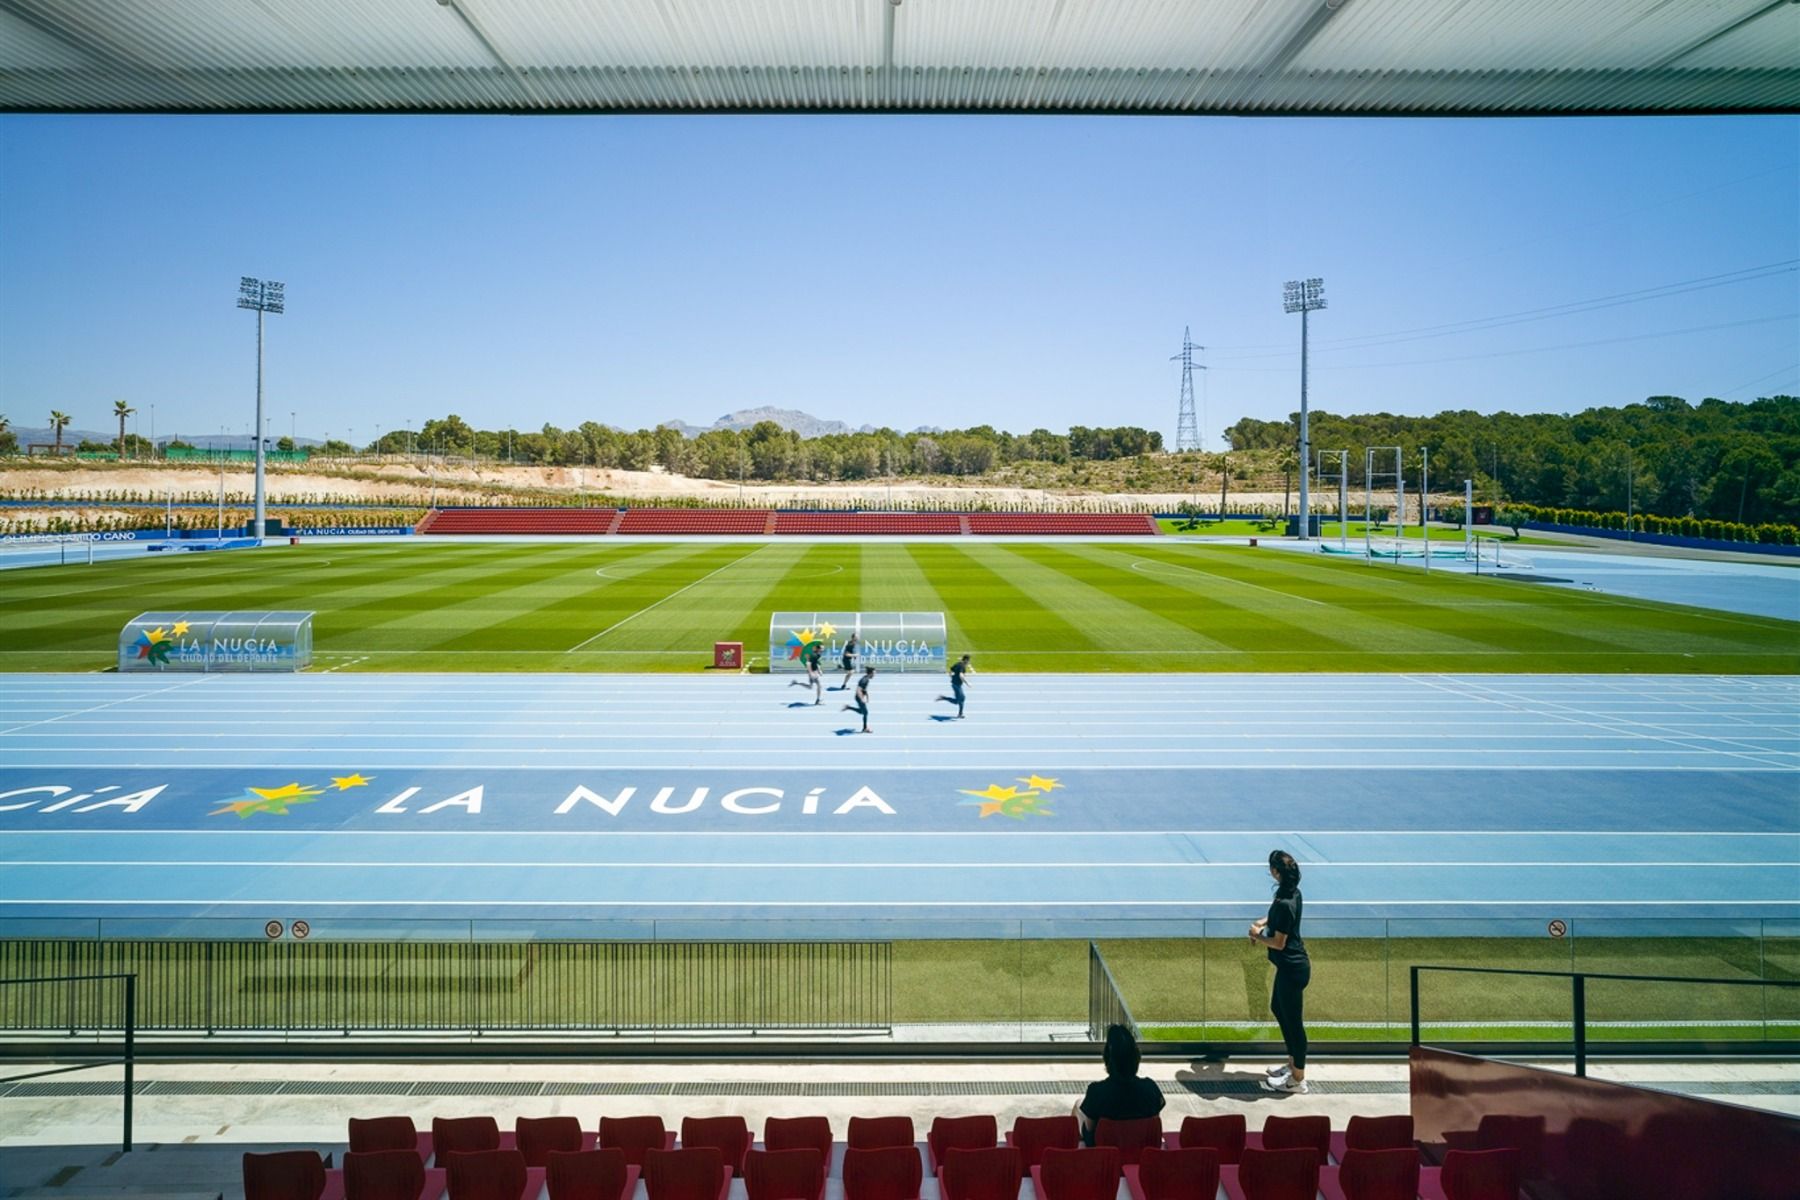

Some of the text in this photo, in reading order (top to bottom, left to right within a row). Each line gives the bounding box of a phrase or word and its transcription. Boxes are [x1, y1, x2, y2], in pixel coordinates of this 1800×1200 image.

[103, 532, 136, 541] CANO
[181, 638, 201, 652] LA
[181, 653, 278, 663] CIUDAD DEL DEPORTE
[375, 785, 484, 814] LA
